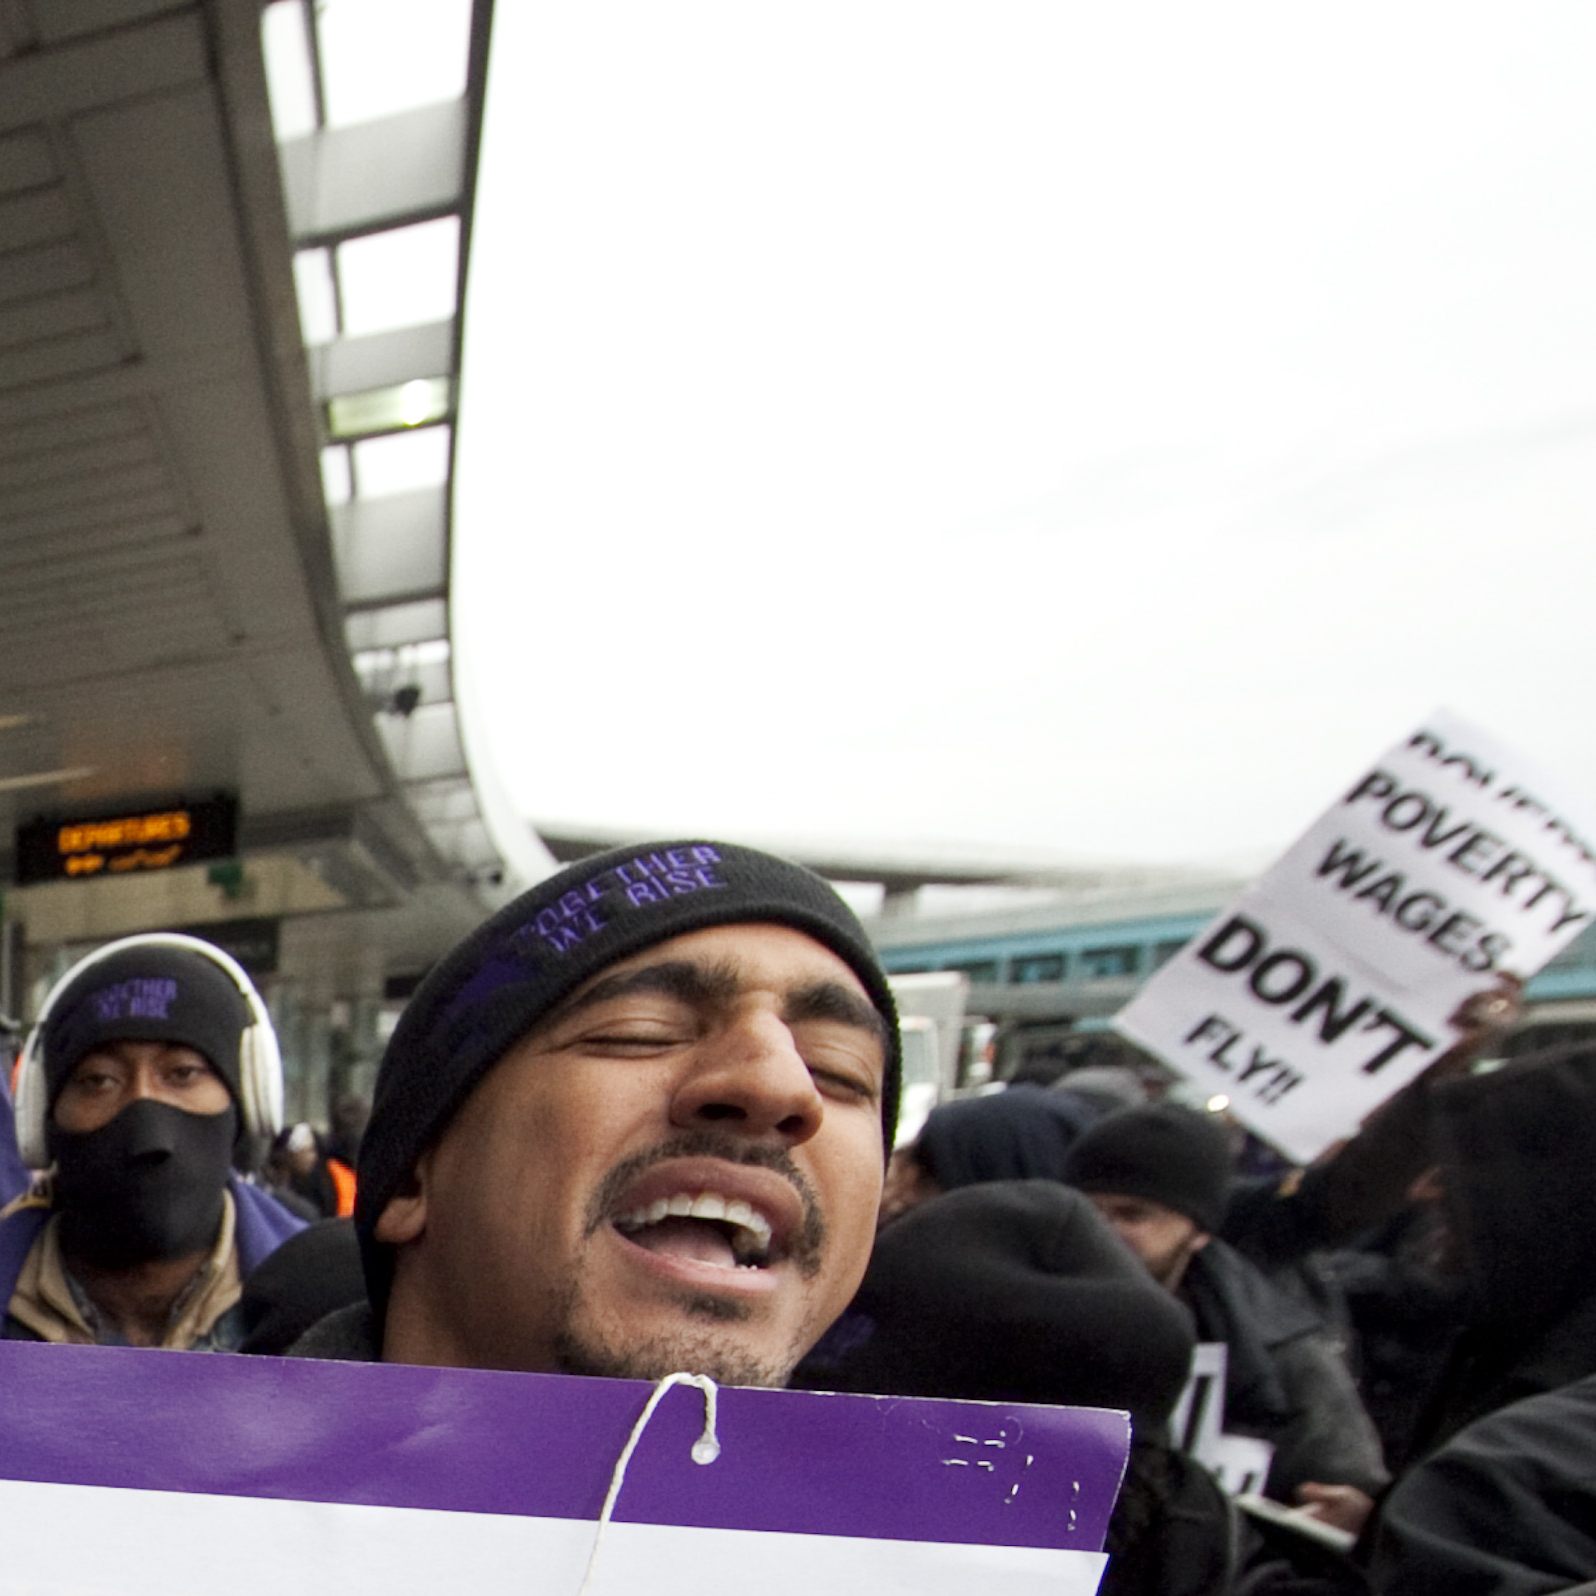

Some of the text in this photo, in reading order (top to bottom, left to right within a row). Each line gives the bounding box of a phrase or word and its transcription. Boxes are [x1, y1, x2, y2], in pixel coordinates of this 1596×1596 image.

[625, 866, 728, 908] RISE
[1316, 837, 1512, 974] WAGES
[1342, 767, 1586, 935] POVERTY
[1183, 1012, 1304, 1107] FLY!!
[1196, 913, 1432, 1076] DON'T
